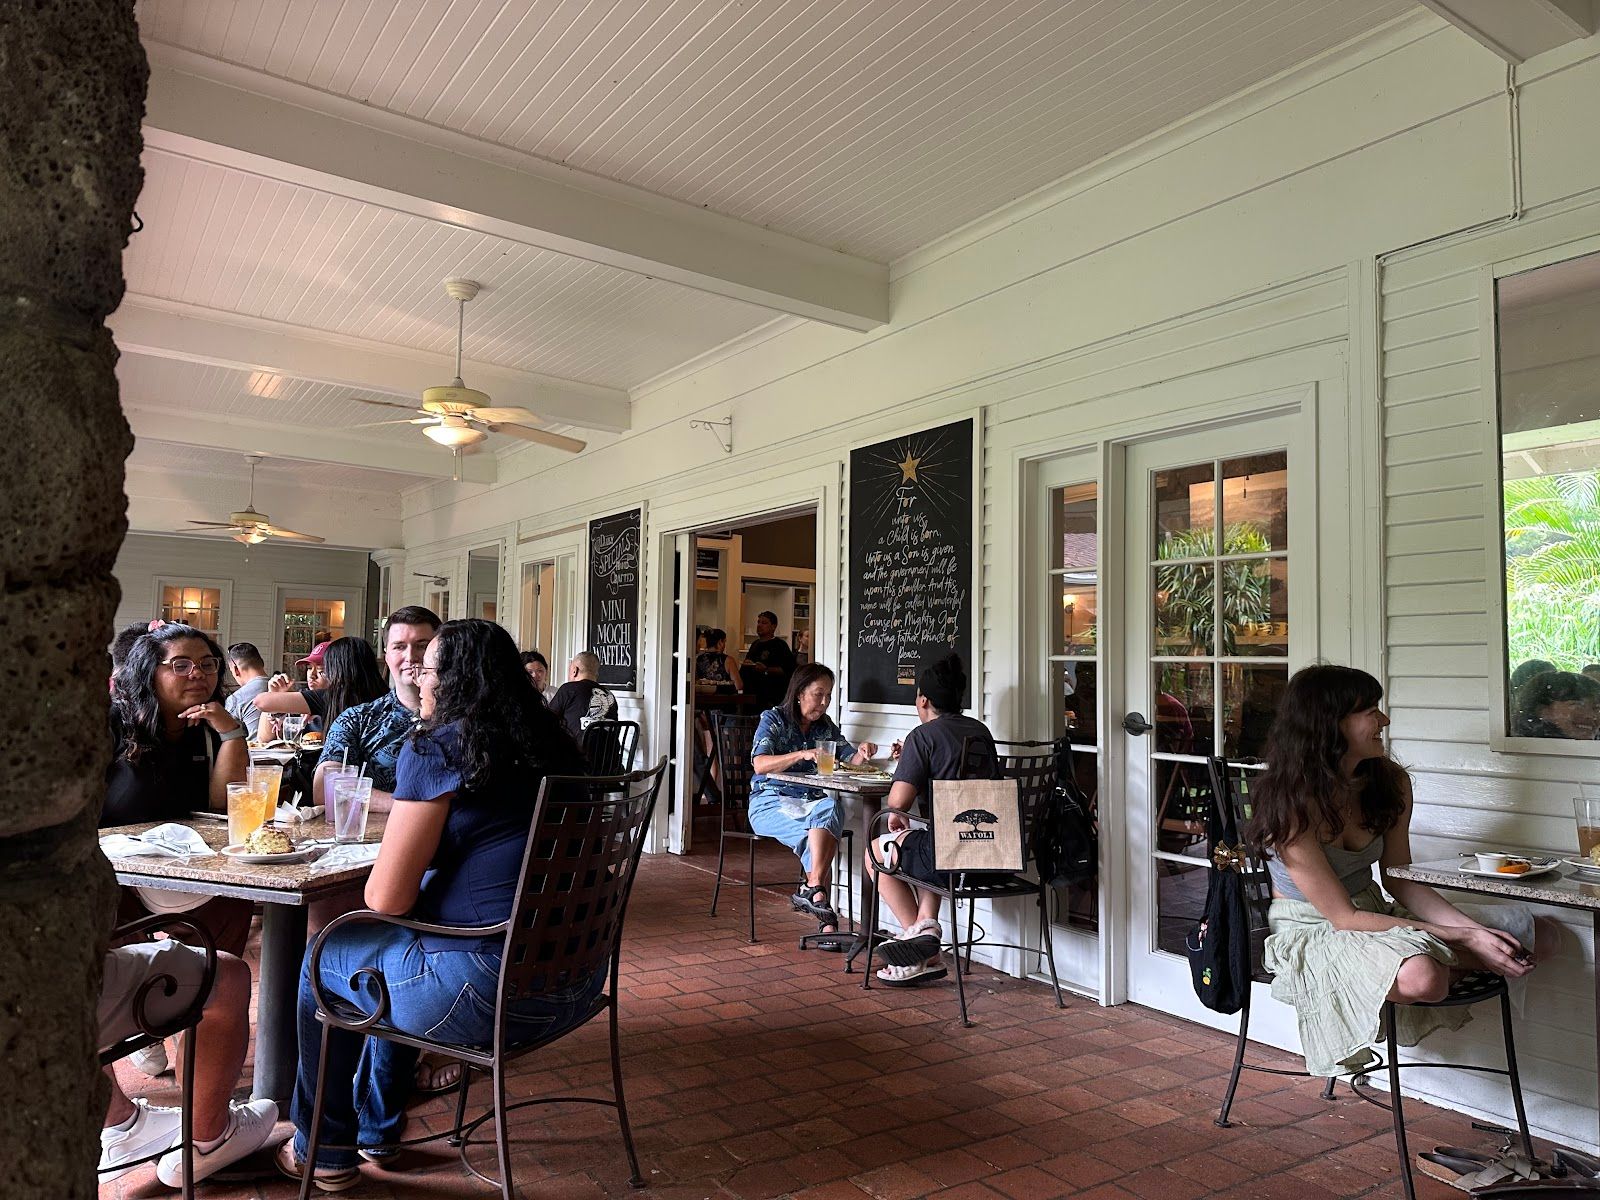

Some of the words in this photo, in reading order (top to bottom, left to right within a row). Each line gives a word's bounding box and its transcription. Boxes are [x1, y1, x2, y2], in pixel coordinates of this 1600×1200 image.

[896, 486, 917, 515] For
[892, 512, 911, 529] unto
[887, 525, 910, 545] Child
[911, 529, 919, 545] is
[599, 533, 631, 575] SPECIALS
[883, 552, 892, 567] us
[894, 552, 900, 560] a
[901, 545, 919, 565] Son
[921, 545, 929, 562] is
[929, 542, 954, 565] given
[863, 565, 876, 580] and
[877, 564, 888, 581] the
[890, 563, 931, 580] government
[931, 558, 947, 574] will
[947, 556, 957, 575] be
[860, 602, 877, 611] name
[880, 597, 892, 612] will
[893, 596, 901, 612] be
[905, 594, 925, 611] called
[928, 589, 965, 610] Wonderful
[864, 586, 883, 601] upon
[883, 580, 896, 598] His
[928, 577, 945, 591] And
[945, 576, 958, 594] His
[601, 599, 626, 622] MINI
[905, 610, 935, 635] Mighty
[938, 610, 958, 633] God
[597, 623, 631, 645] MOCHI
[858, 629, 896, 653] Everlasting
[921, 629, 945, 645] Prince
[947, 626, 960, 649] of
[593, 645, 631, 667] WAFFLES
